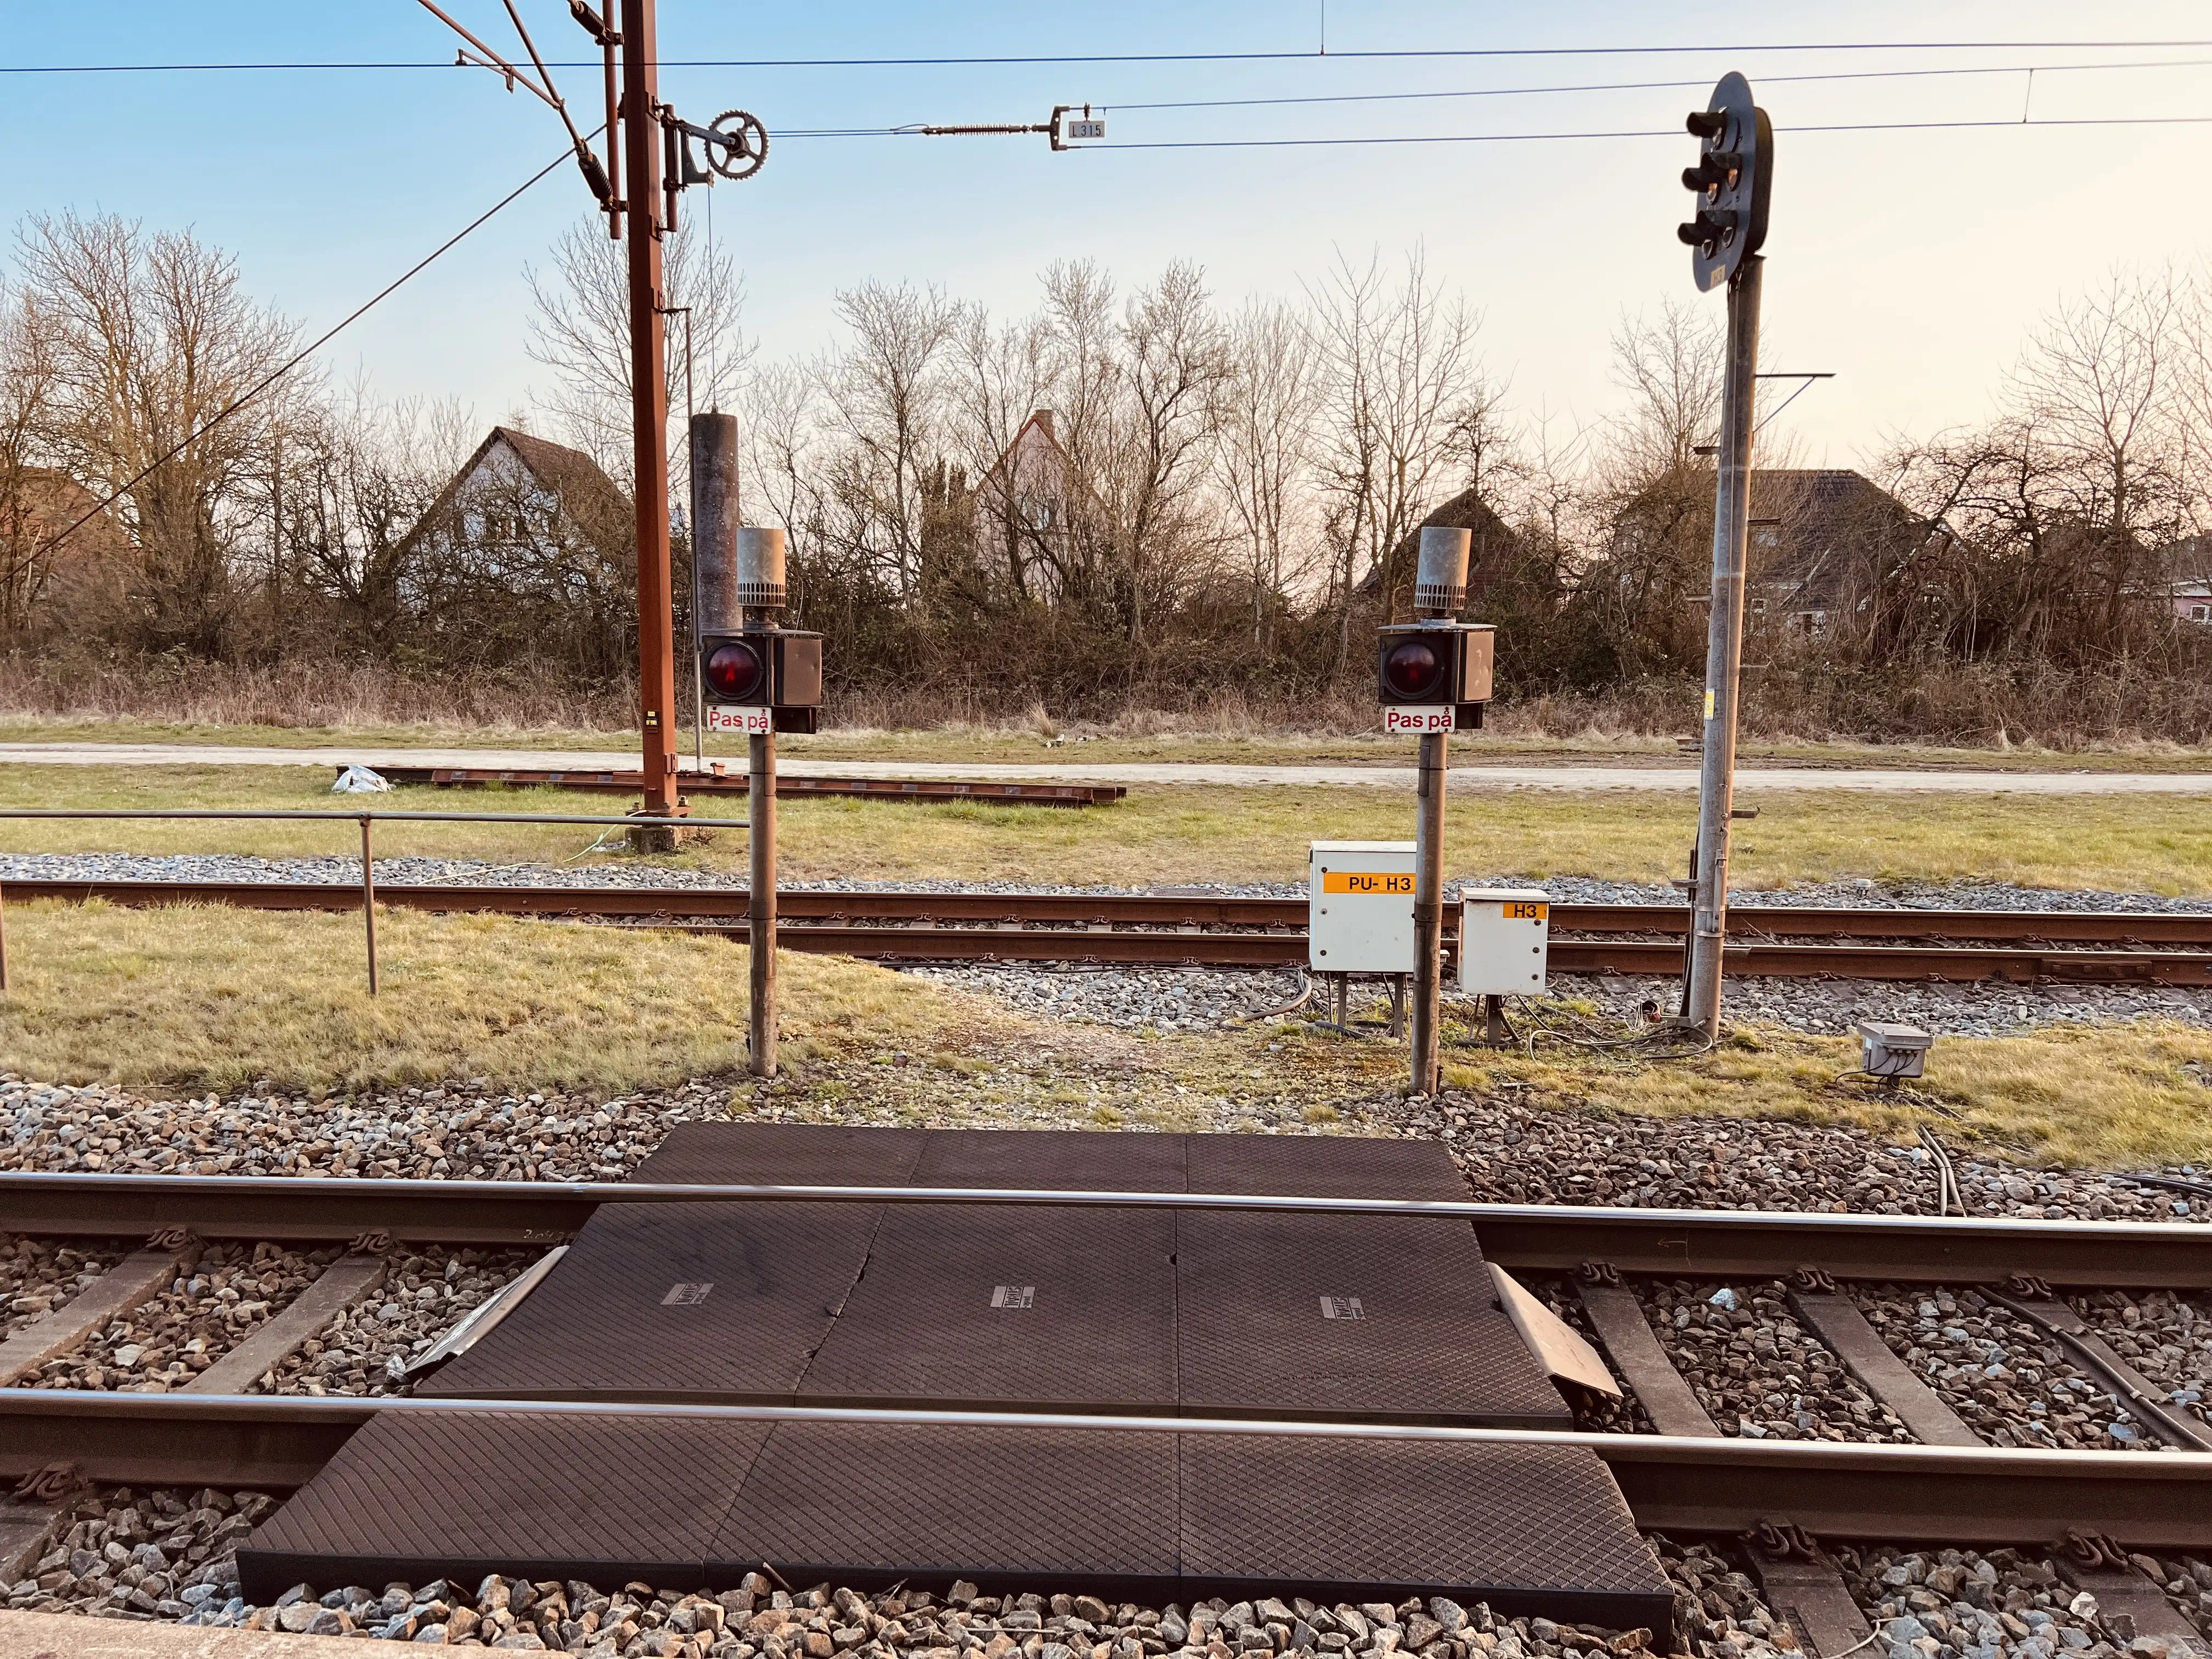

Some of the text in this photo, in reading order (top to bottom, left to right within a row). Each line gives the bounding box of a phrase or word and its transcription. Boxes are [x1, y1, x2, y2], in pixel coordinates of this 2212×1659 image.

[709, 711, 768, 731] Pas på
[1388, 710, 1452, 731] Pas på
[1387, 877, 1411, 890] H3
[1514, 904, 1537, 918] H3
